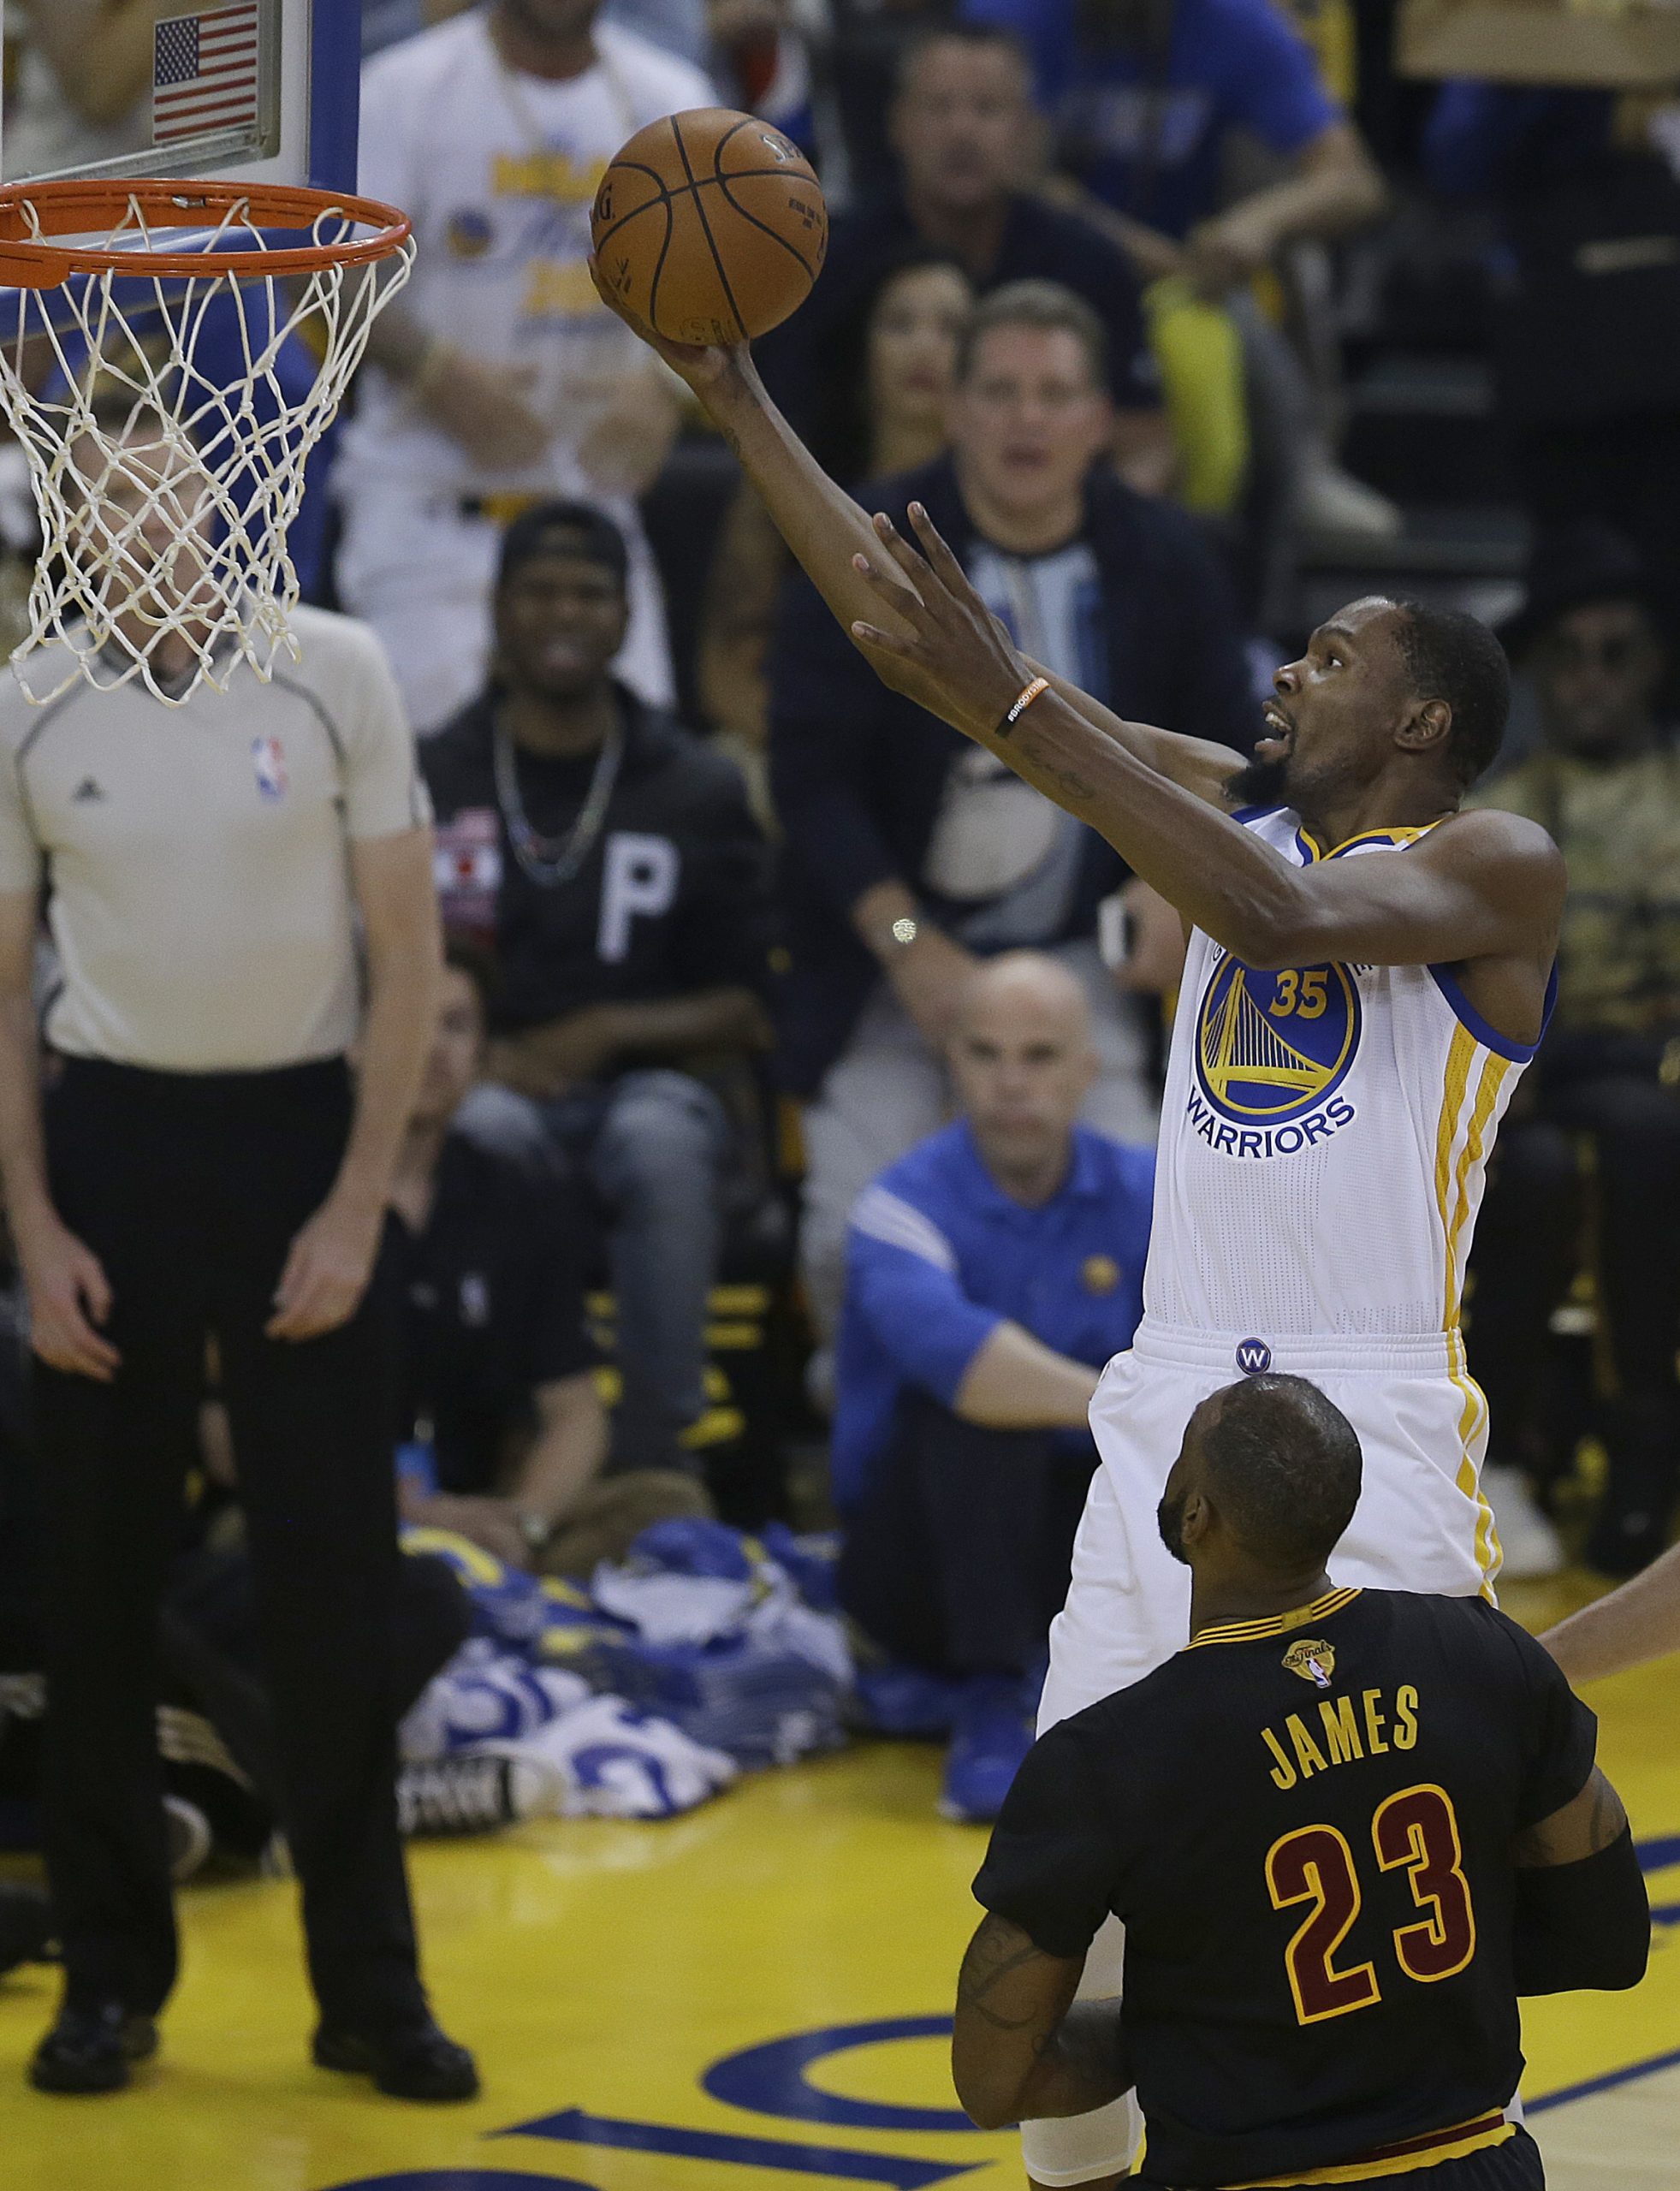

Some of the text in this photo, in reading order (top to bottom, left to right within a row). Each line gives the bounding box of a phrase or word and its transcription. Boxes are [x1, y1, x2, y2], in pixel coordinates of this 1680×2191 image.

[597, 831, 680, 964] P
[1267, 969, 1328, 1018] 35
[1187, 1084, 1355, 1159] WARRIORS
[1240, 1348, 1266, 1367] W
[1293, 1641, 1332, 1665] Finals
[1261, 1684, 1418, 1790] JAMES
[1265, 1783, 1476, 2025] 23
